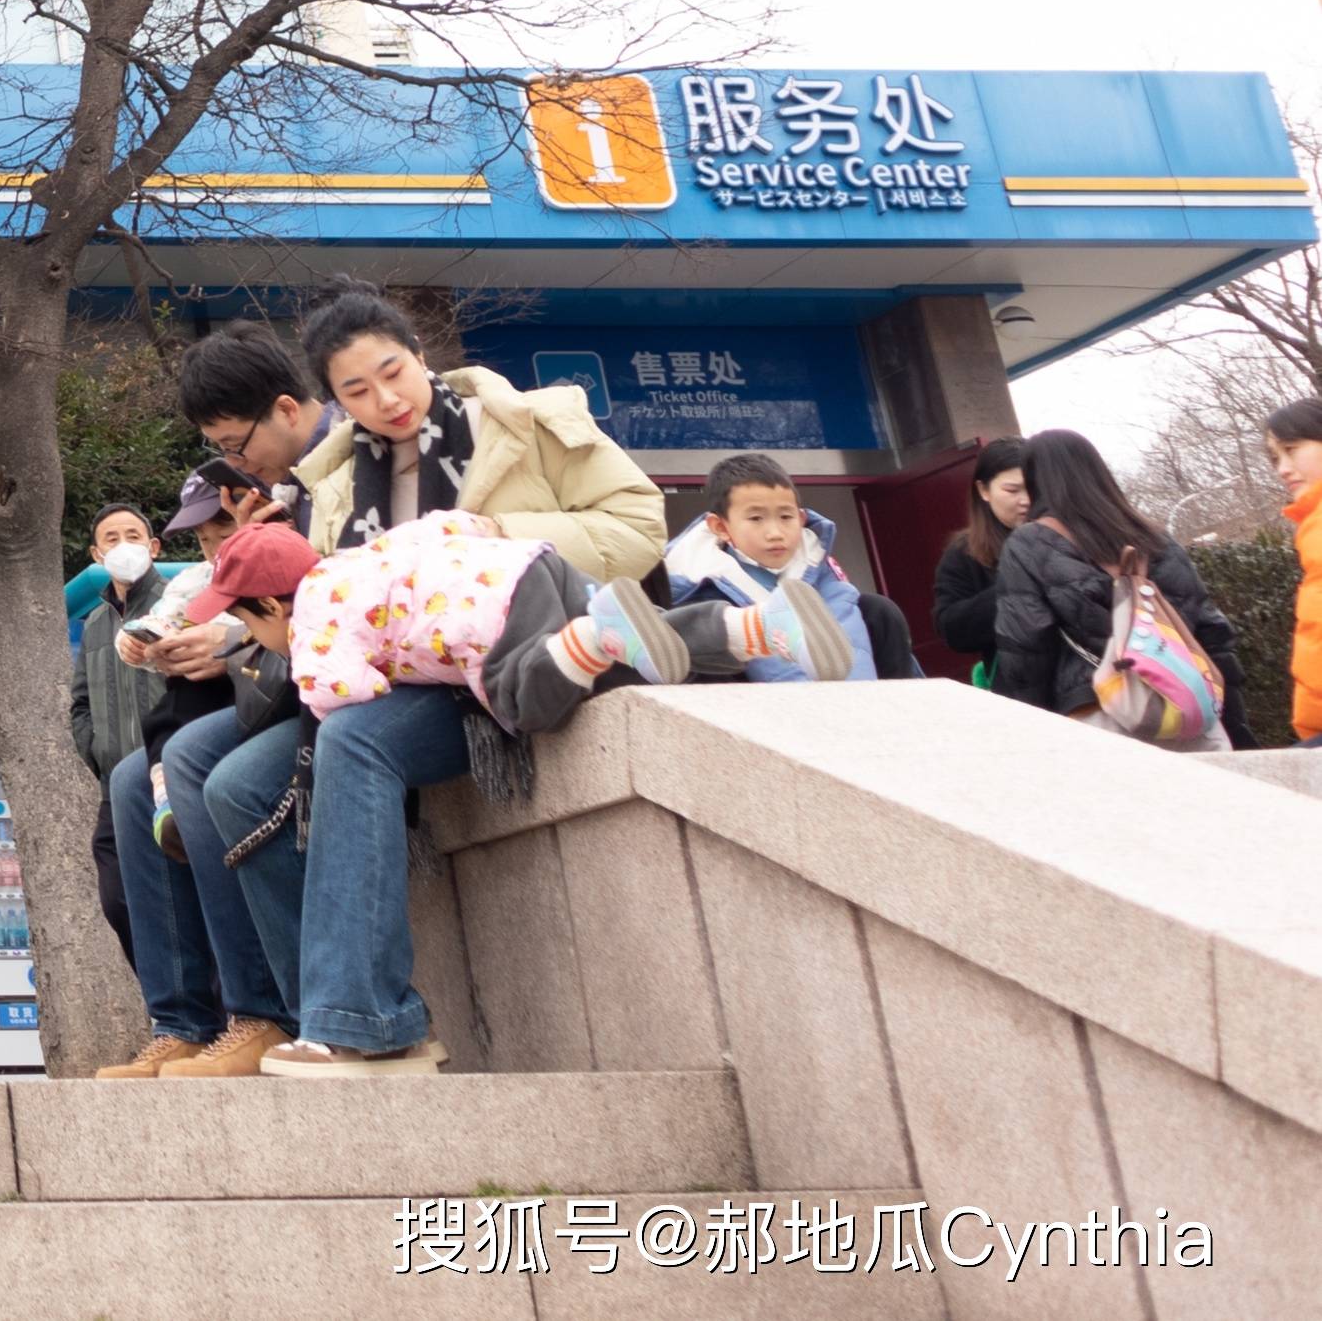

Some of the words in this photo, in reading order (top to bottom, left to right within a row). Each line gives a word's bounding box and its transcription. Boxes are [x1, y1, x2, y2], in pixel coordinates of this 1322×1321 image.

[680, 74, 966, 156] 服务处
[696, 156, 837, 188] Service
[843, 157, 971, 189] Center
[715, 190, 869, 208] サービスセンター
[630, 350, 747, 387] 售票处
[649, 390, 694, 404] Ticket
[696, 389, 738, 403] Office
